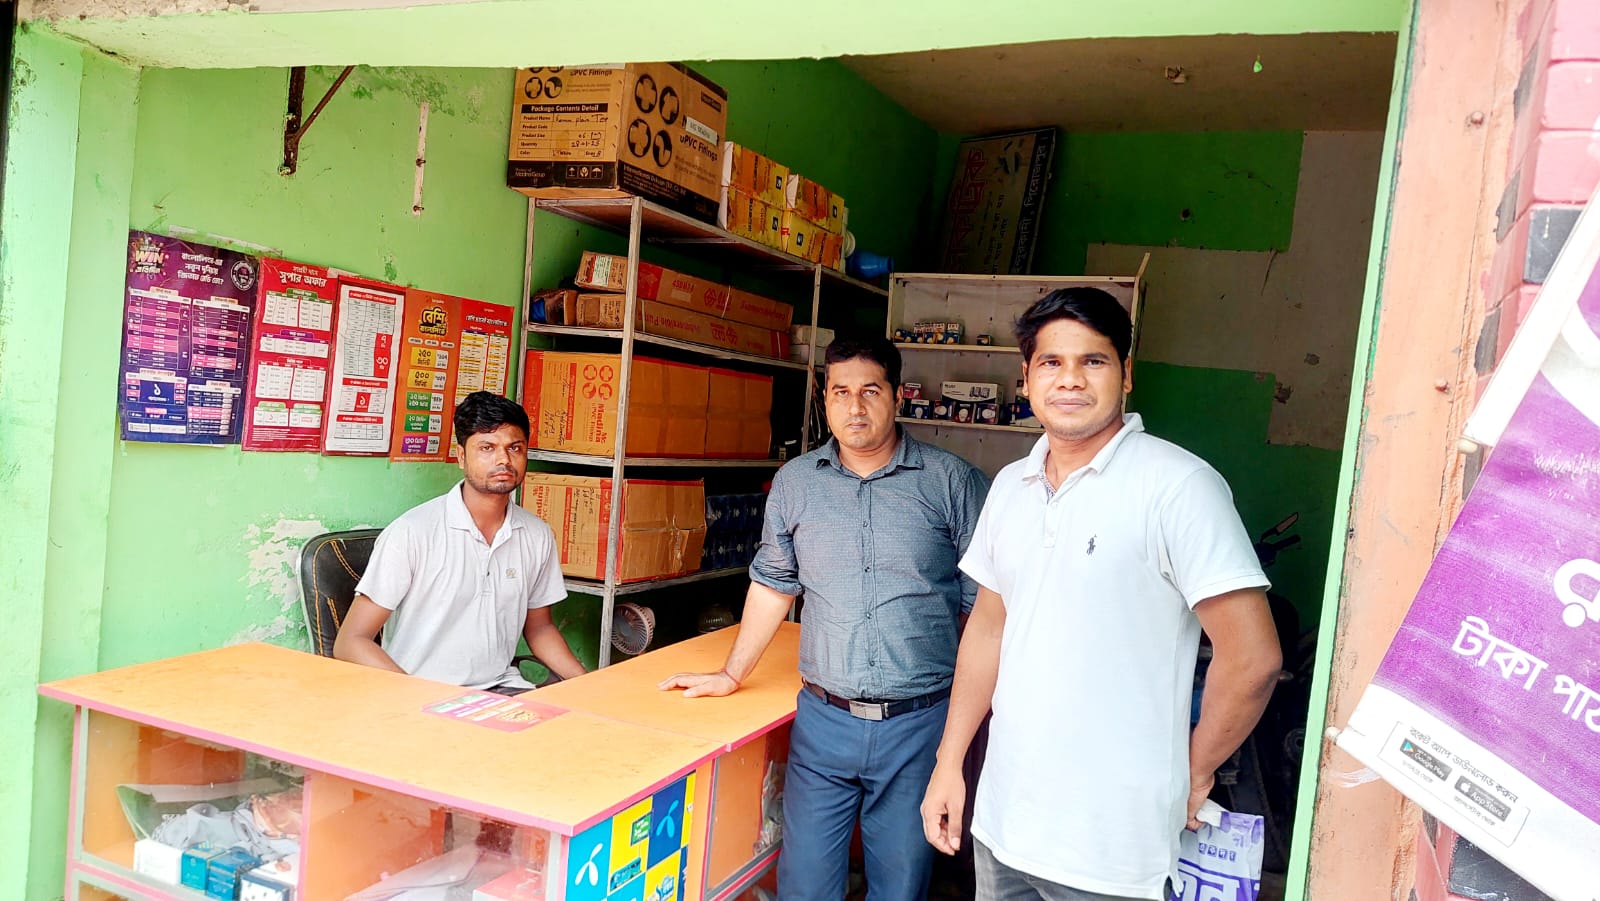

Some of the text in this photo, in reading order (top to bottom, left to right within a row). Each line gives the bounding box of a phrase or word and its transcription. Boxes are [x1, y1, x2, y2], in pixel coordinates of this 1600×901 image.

[531, 105, 554, 113] Package
[556, 104, 580, 112] Contents
[135, 250, 164, 264] WIN
[279, 270, 328, 288] সুপার অফার
[422, 307, 446, 324] বেশি
[376, 356, 389, 365] ৩০
[414, 371, 430, 379] ৫০০
[595, 403, 605, 443] Madina
[536, 486, 544, 518] adina
[1452, 615, 1549, 691] টাকা
[1410, 727, 1518, 803] রকেট অ্যাপ ডাউনলোড করুন
[1414, 752, 1434, 769] Google
[1433, 763, 1445, 778] Play
[1470, 791, 1503, 817] App Store
